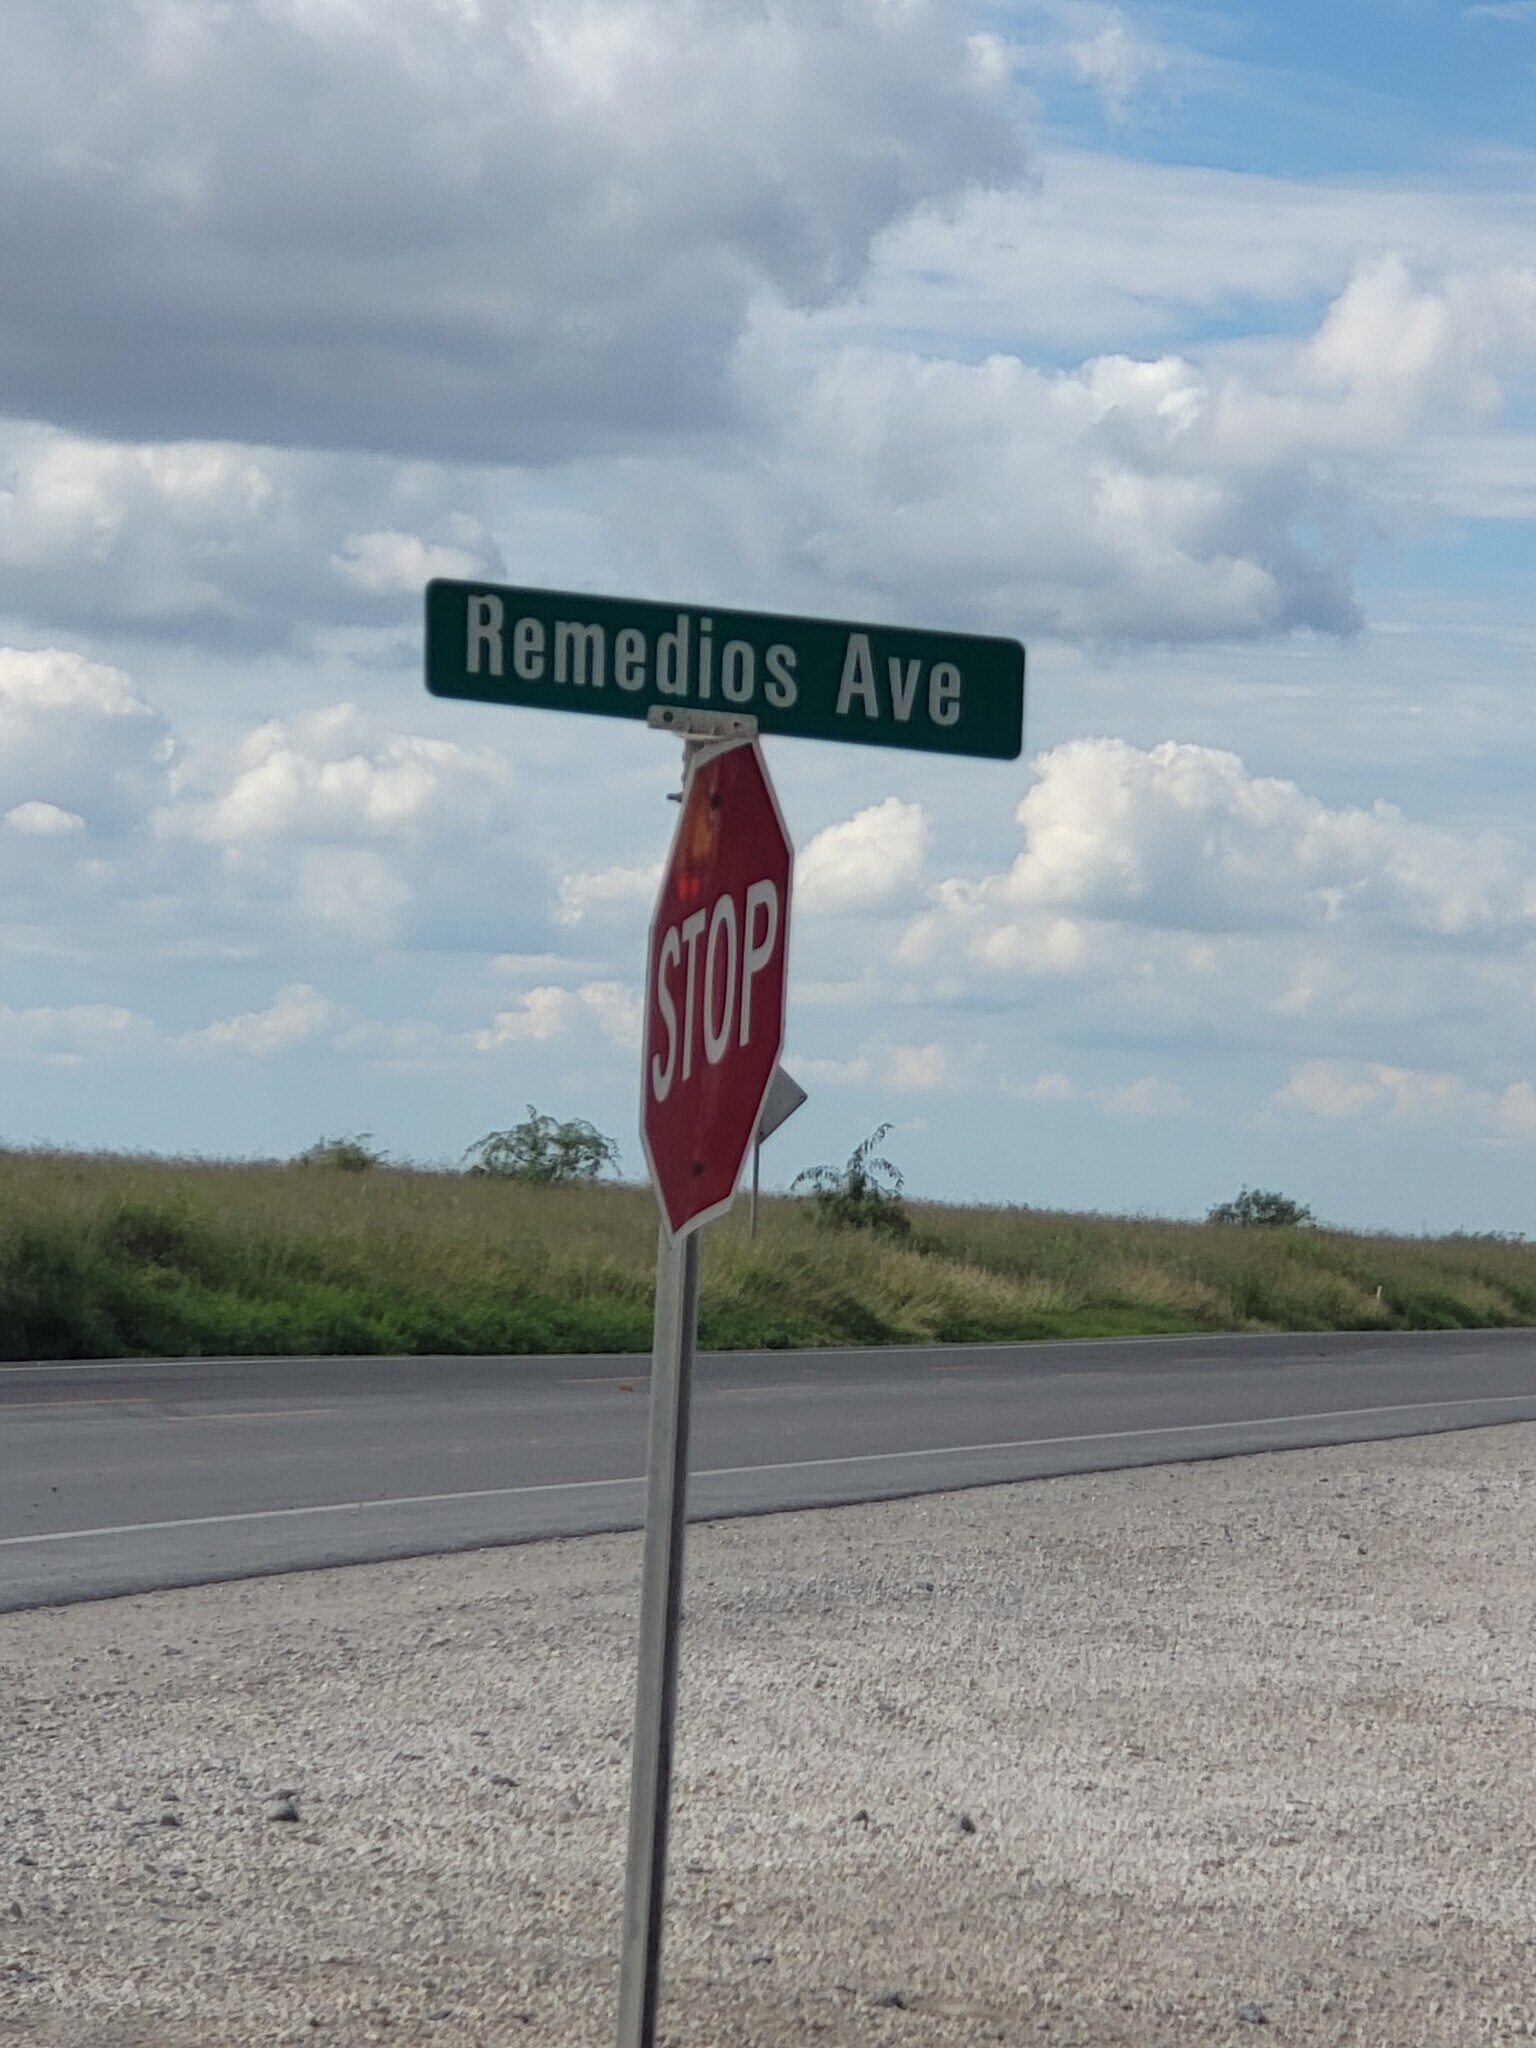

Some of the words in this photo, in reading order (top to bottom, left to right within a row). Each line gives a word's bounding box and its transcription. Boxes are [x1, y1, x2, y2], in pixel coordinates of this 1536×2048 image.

[466, 594, 798, 708] Remedios
[836, 632, 962, 726] Ave
[652, 878, 778, 1102] STOP
